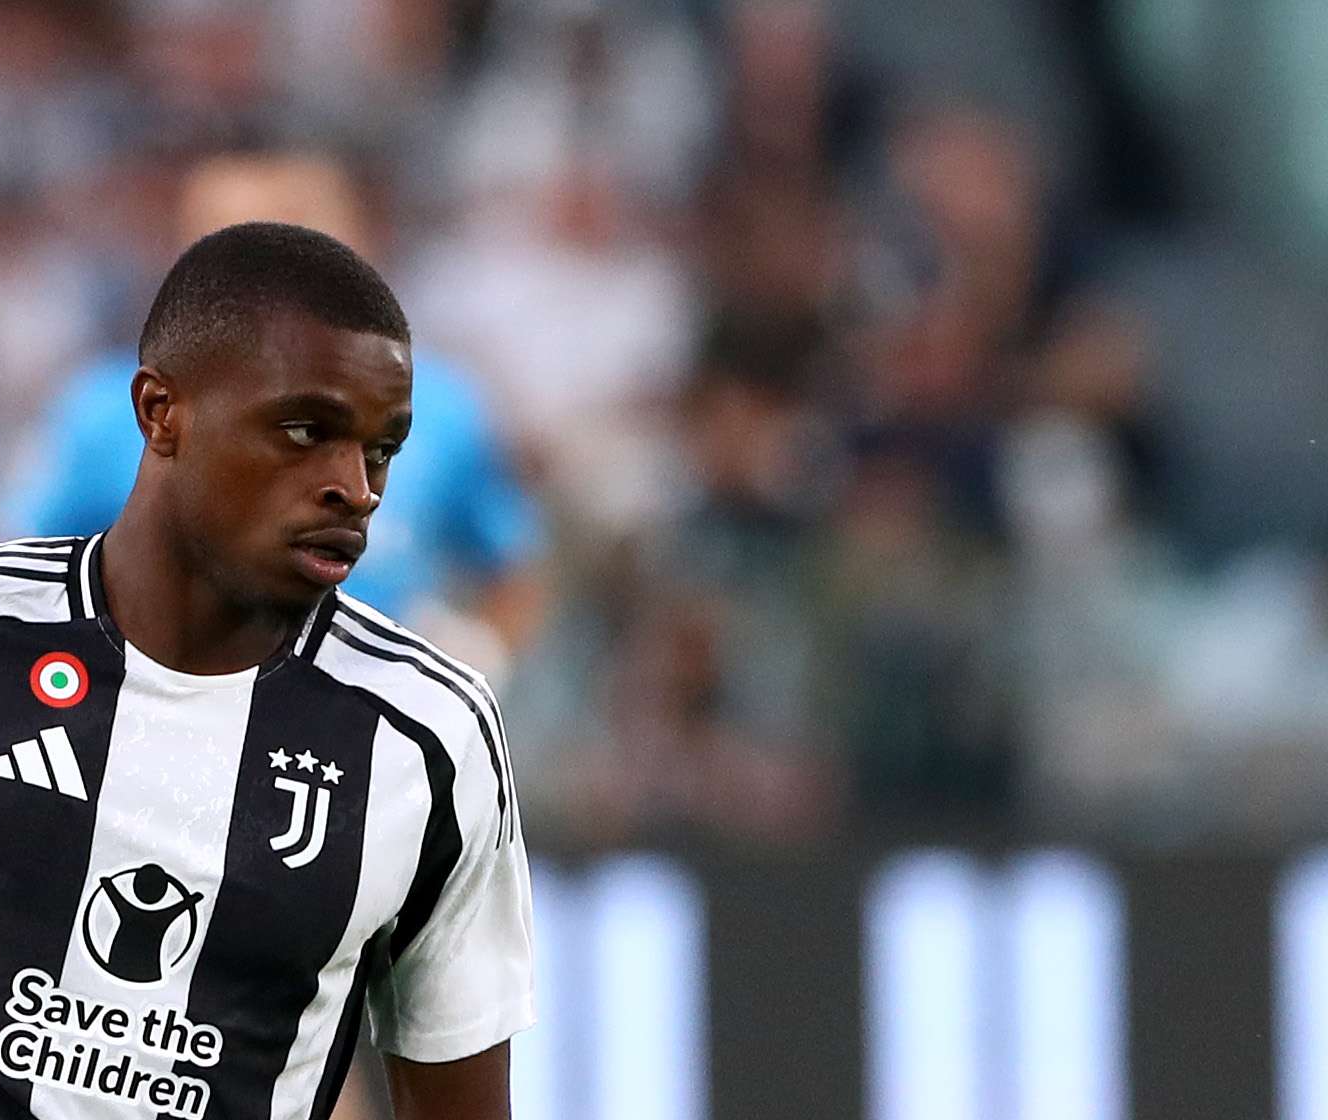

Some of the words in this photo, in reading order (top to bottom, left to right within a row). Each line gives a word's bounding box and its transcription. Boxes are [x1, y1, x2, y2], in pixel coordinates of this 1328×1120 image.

[13, 974, 130, 1039] Save
[141, 1008, 217, 1061] the
[0, 1028, 205, 1116] Children
